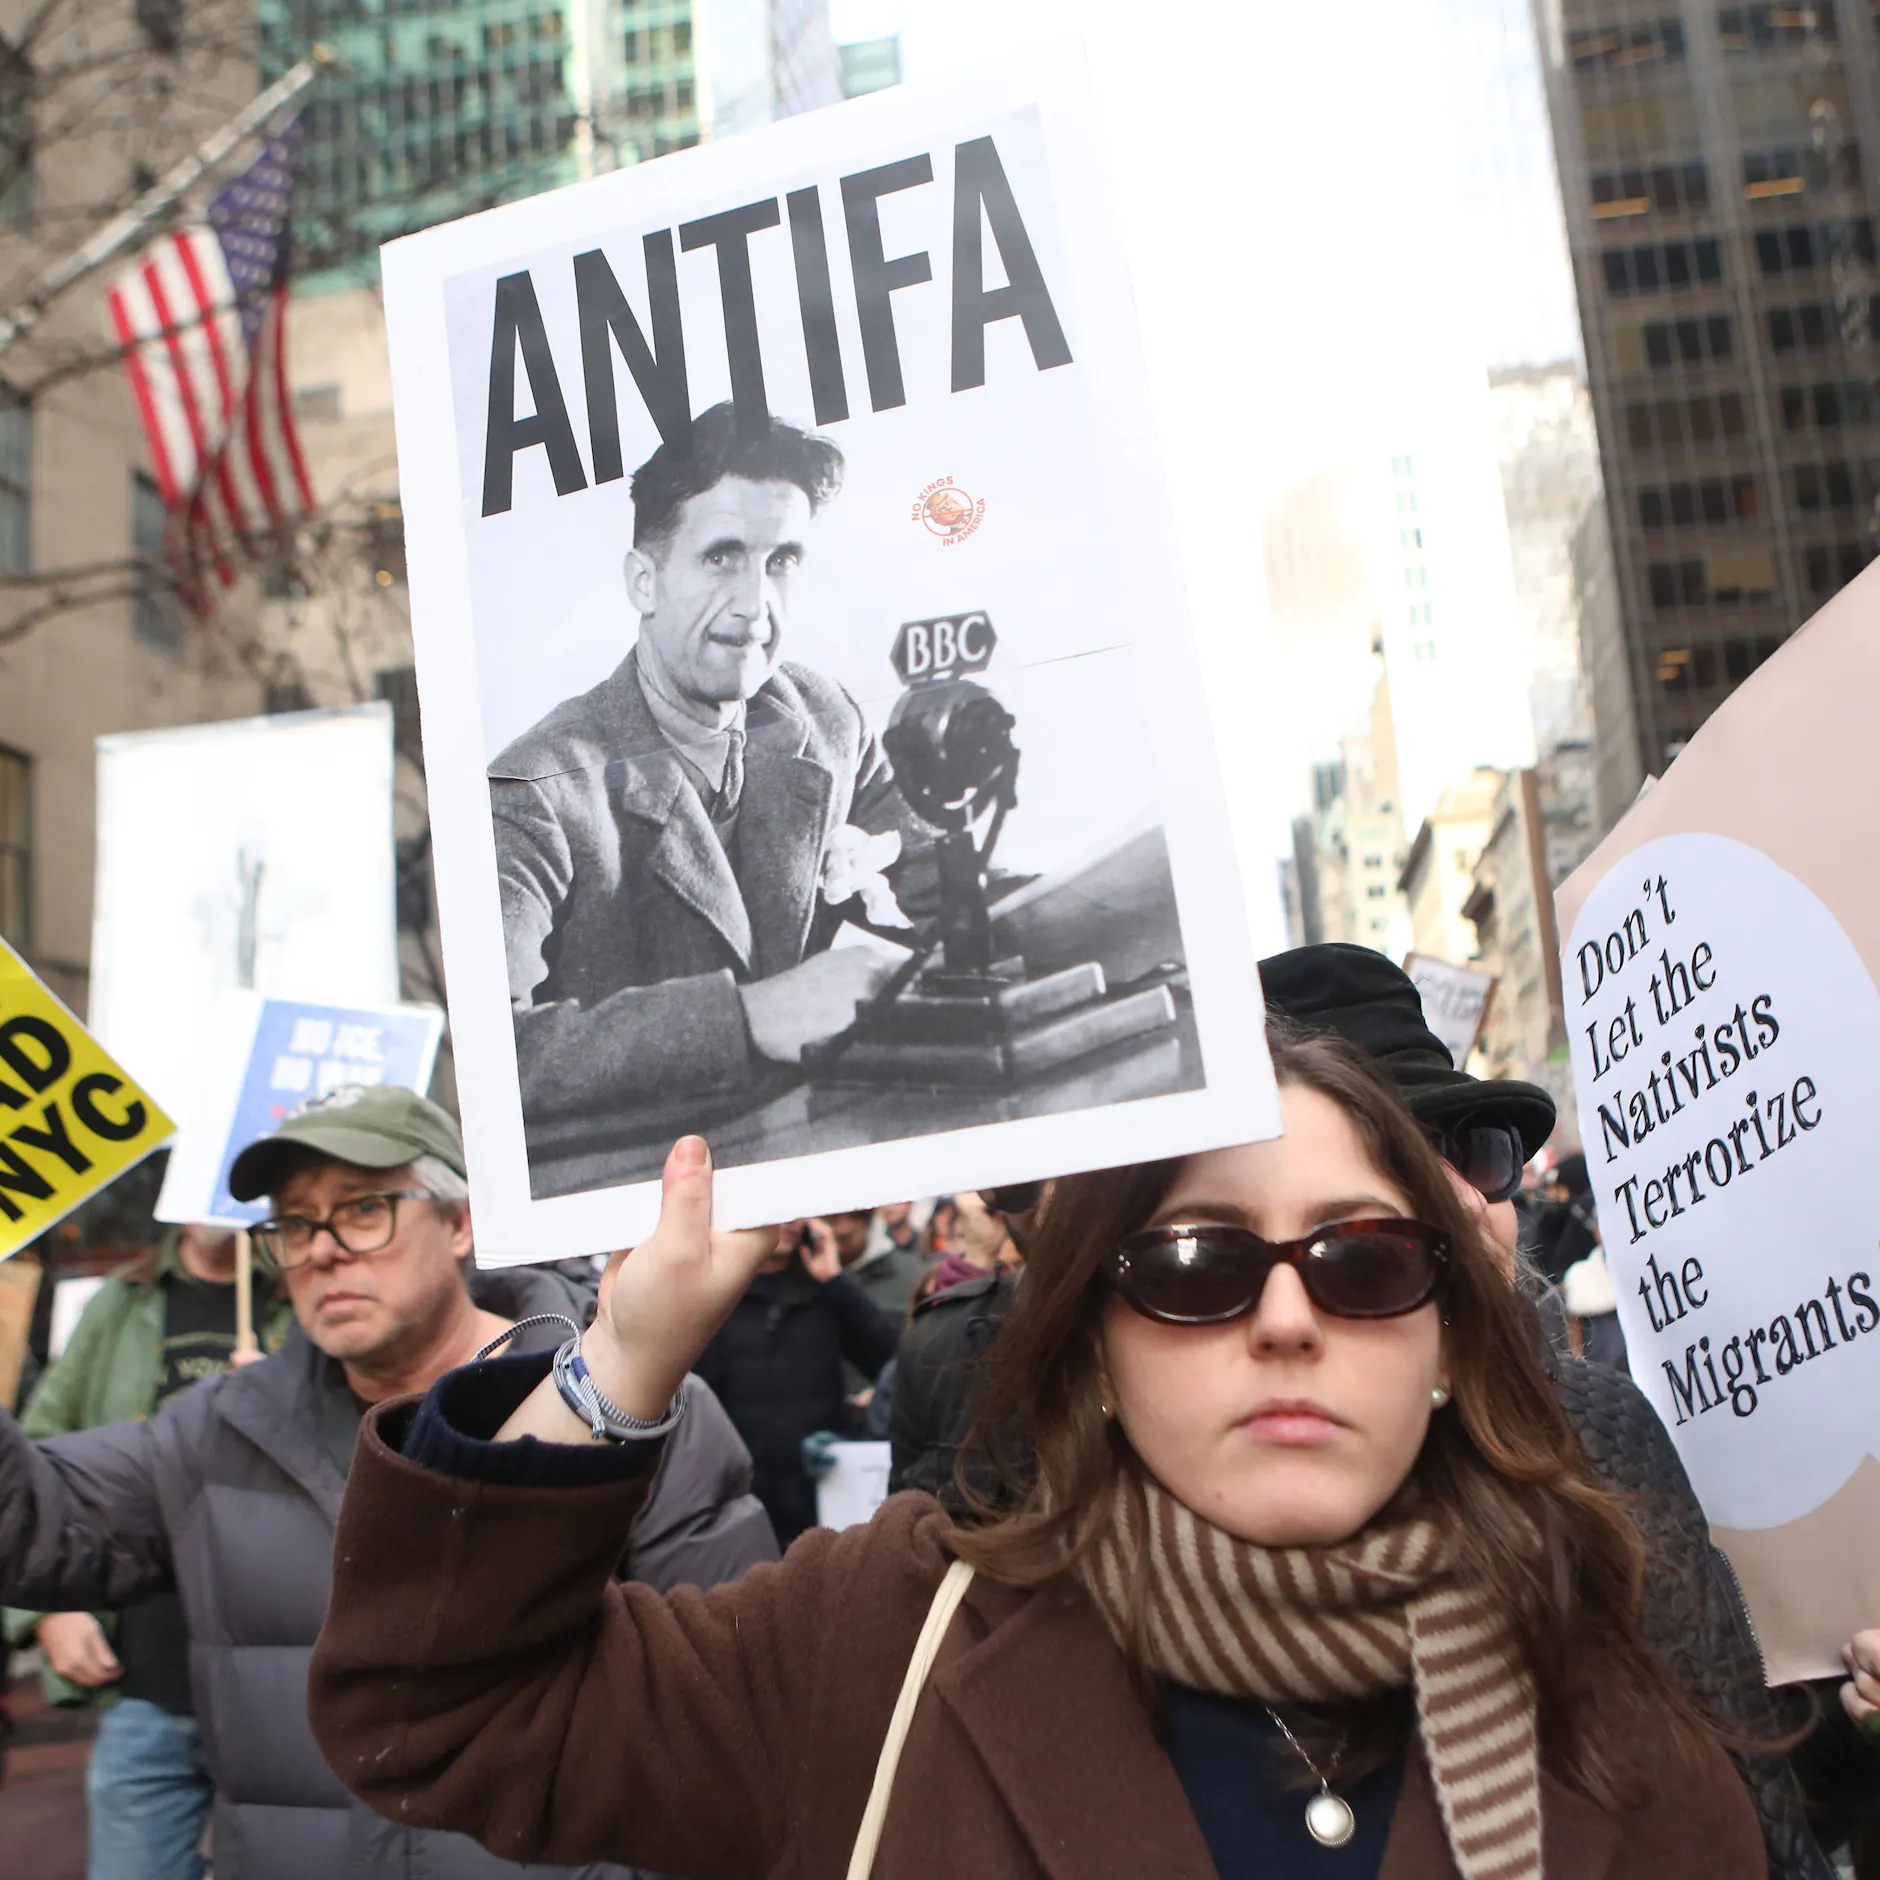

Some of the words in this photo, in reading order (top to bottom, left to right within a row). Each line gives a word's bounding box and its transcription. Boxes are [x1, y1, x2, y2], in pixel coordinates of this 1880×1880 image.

[481, 135, 1074, 518] ANTIFA
[911, 503, 921, 521] NO
[917, 476, 954, 501] KINGS
[943, 537, 954, 546] IN
[957, 498, 985, 542] AMERICA
[907, 615, 987, 675] BBC
[1585, 995, 1643, 1082] Let
[1649, 941, 1716, 1025] the
[1597, 994, 1780, 1163] Nativists
[0, 1072, 147, 1223] NYC
[1614, 1075, 1822, 1244] Terrorize
[1638, 1253, 1709, 1333] the
[1661, 1272, 1880, 1426] Migrants
